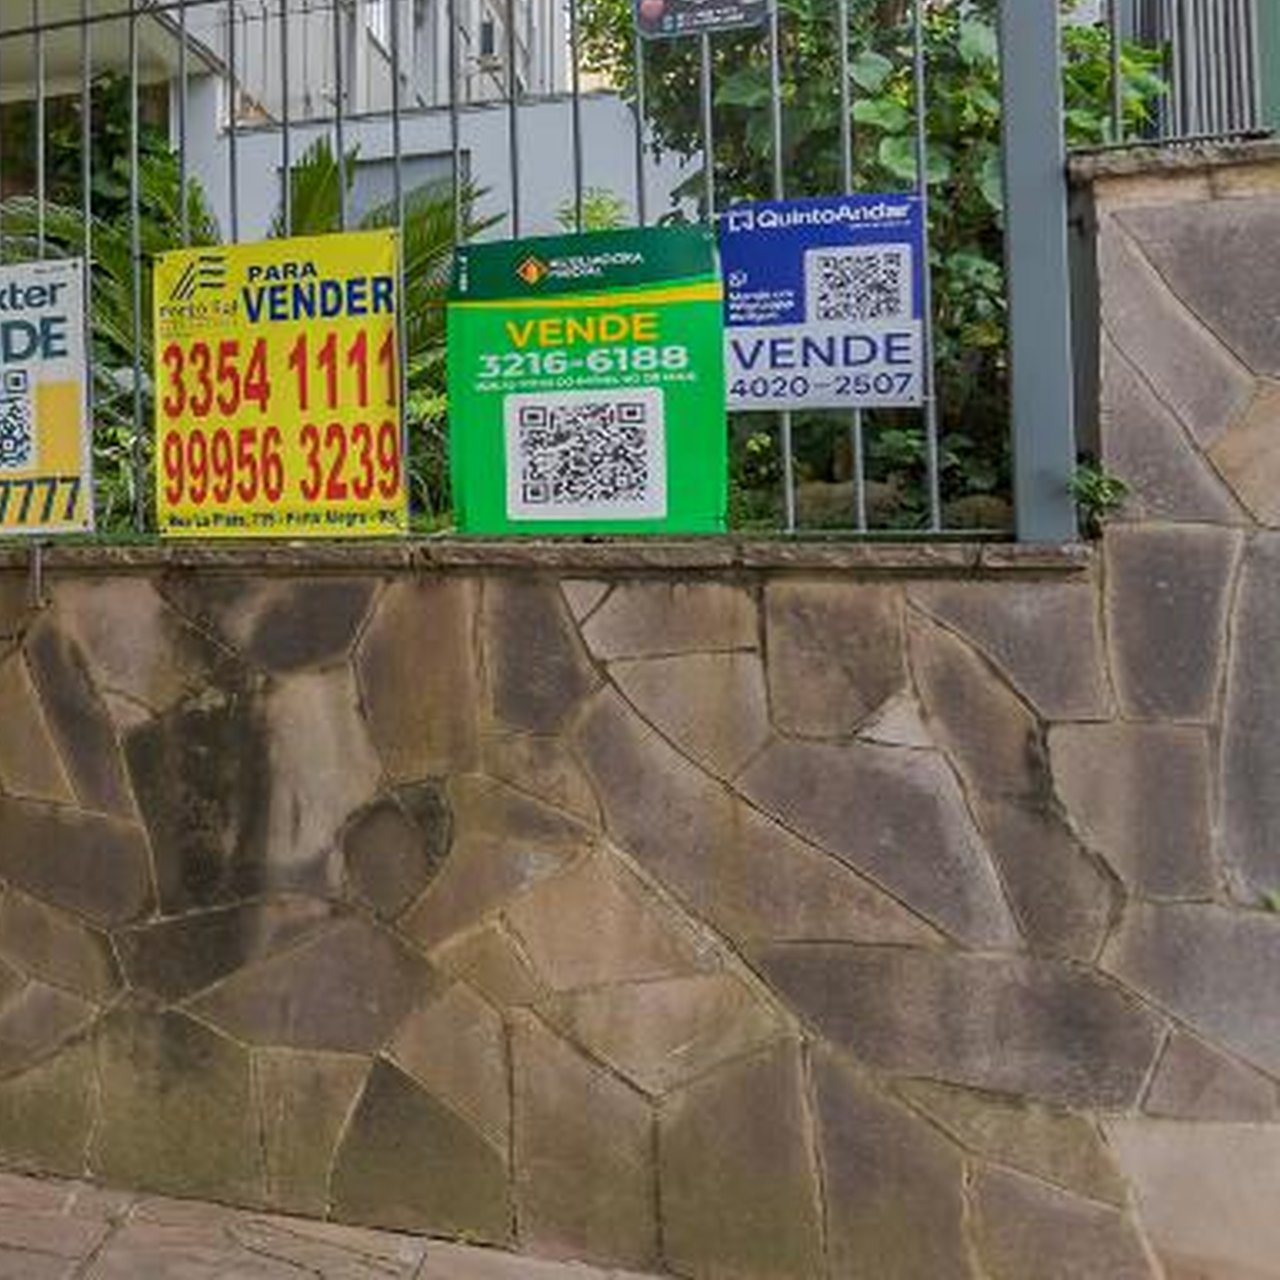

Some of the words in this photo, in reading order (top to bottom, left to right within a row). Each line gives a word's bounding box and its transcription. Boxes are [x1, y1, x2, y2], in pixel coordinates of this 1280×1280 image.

[248, 262, 318, 282] PARA
[243, 276, 394, 323] VENDER
[506, 312, 660, 348] VENDE
[477, 345, 690, 378] 3216-6188
[731, 333, 912, 370] VENDE
[162, 336, 271, 419] 3354
[288, 328, 396, 412] 1111
[729, 373, 912, 398] 4020-2507
[163, 426, 284, 506] 99956
[299, 421, 400, 502] 3239
